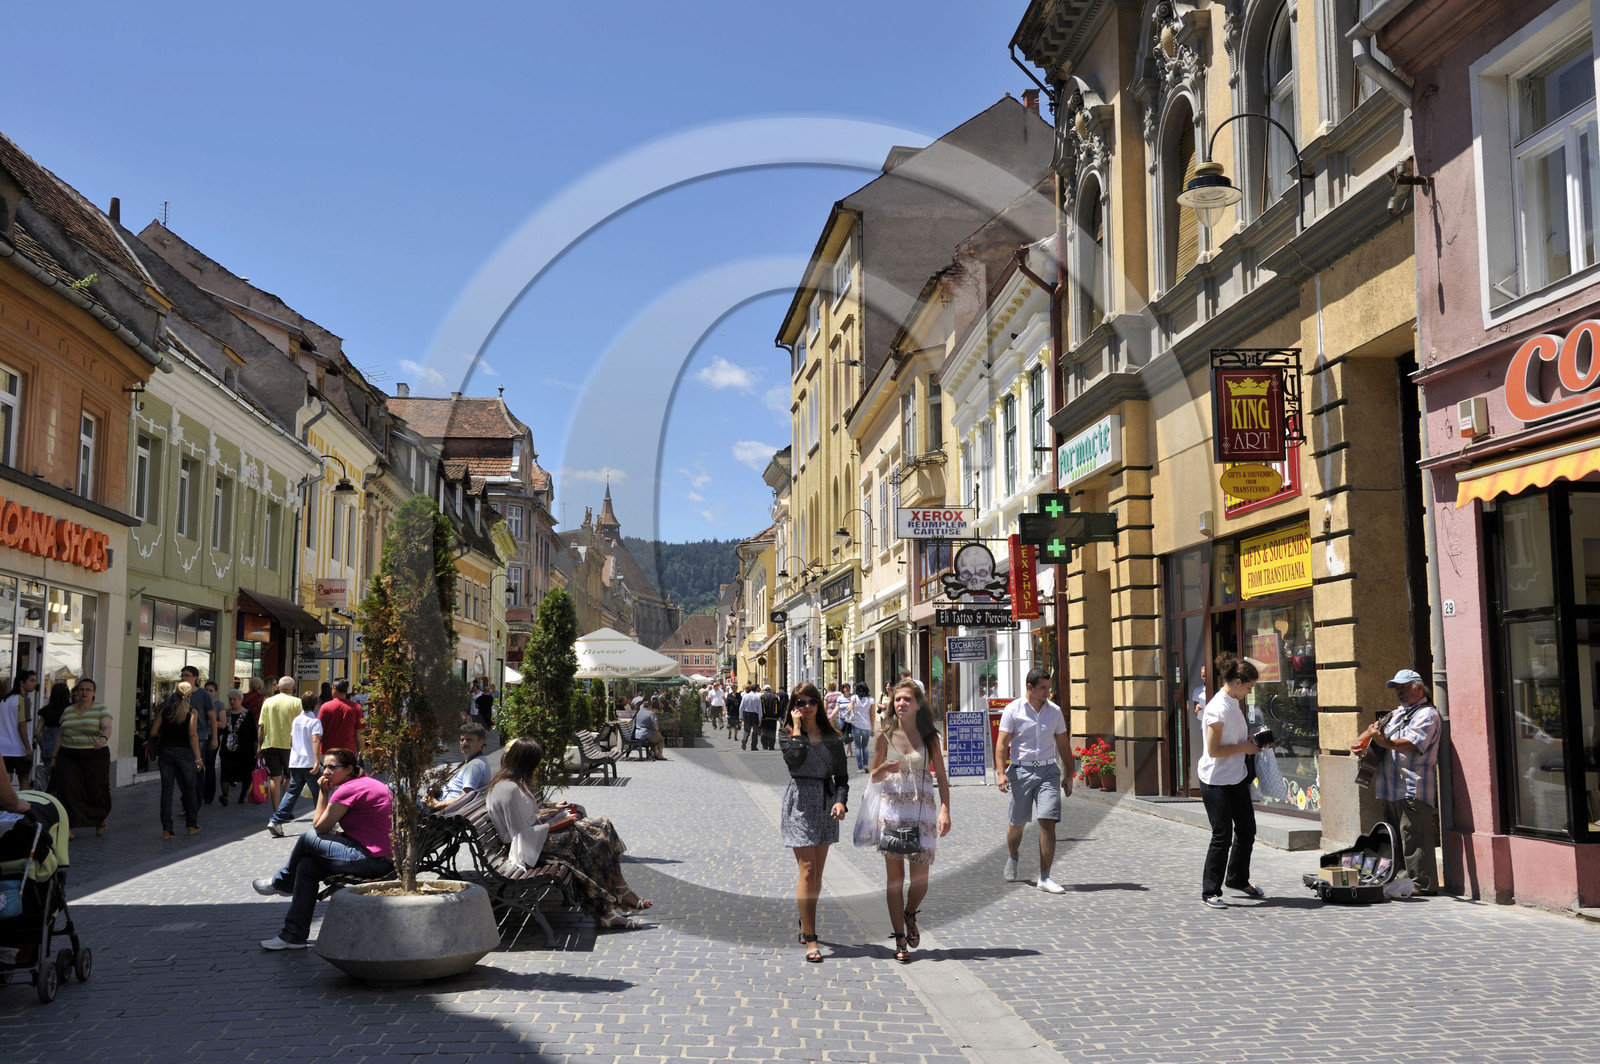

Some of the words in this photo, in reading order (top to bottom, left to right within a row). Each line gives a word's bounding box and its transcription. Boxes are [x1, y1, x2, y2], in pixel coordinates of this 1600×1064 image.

[1231, 399, 1270, 429] KING
[1234, 432, 1270, 449] ART
[1247, 470, 1274, 478] SOUVENIRS
[1233, 485, 1270, 493] TRANSYLVANIA
[911, 510, 964, 521] XEROX
[61, 519, 109, 573] SHOES
[1243, 545, 1262, 568] GIFTS
[1263, 543, 1268, 563] &
[1269, 532, 1309, 562] SOUVENIRS
[1247, 570, 1263, 589] FROM
[1263, 561, 1306, 586] TRANSYLVANIA
[1022, 571, 1031, 609] SHOP
[1445, 602, 1454, 614] 29
[940, 611, 949, 623] Eli
[952, 611, 974, 624] Tattoo
[984, 611, 1013, 627] Piercing
[950, 640, 986, 650] EXCHANGE
[606, 665, 620, 673] City
